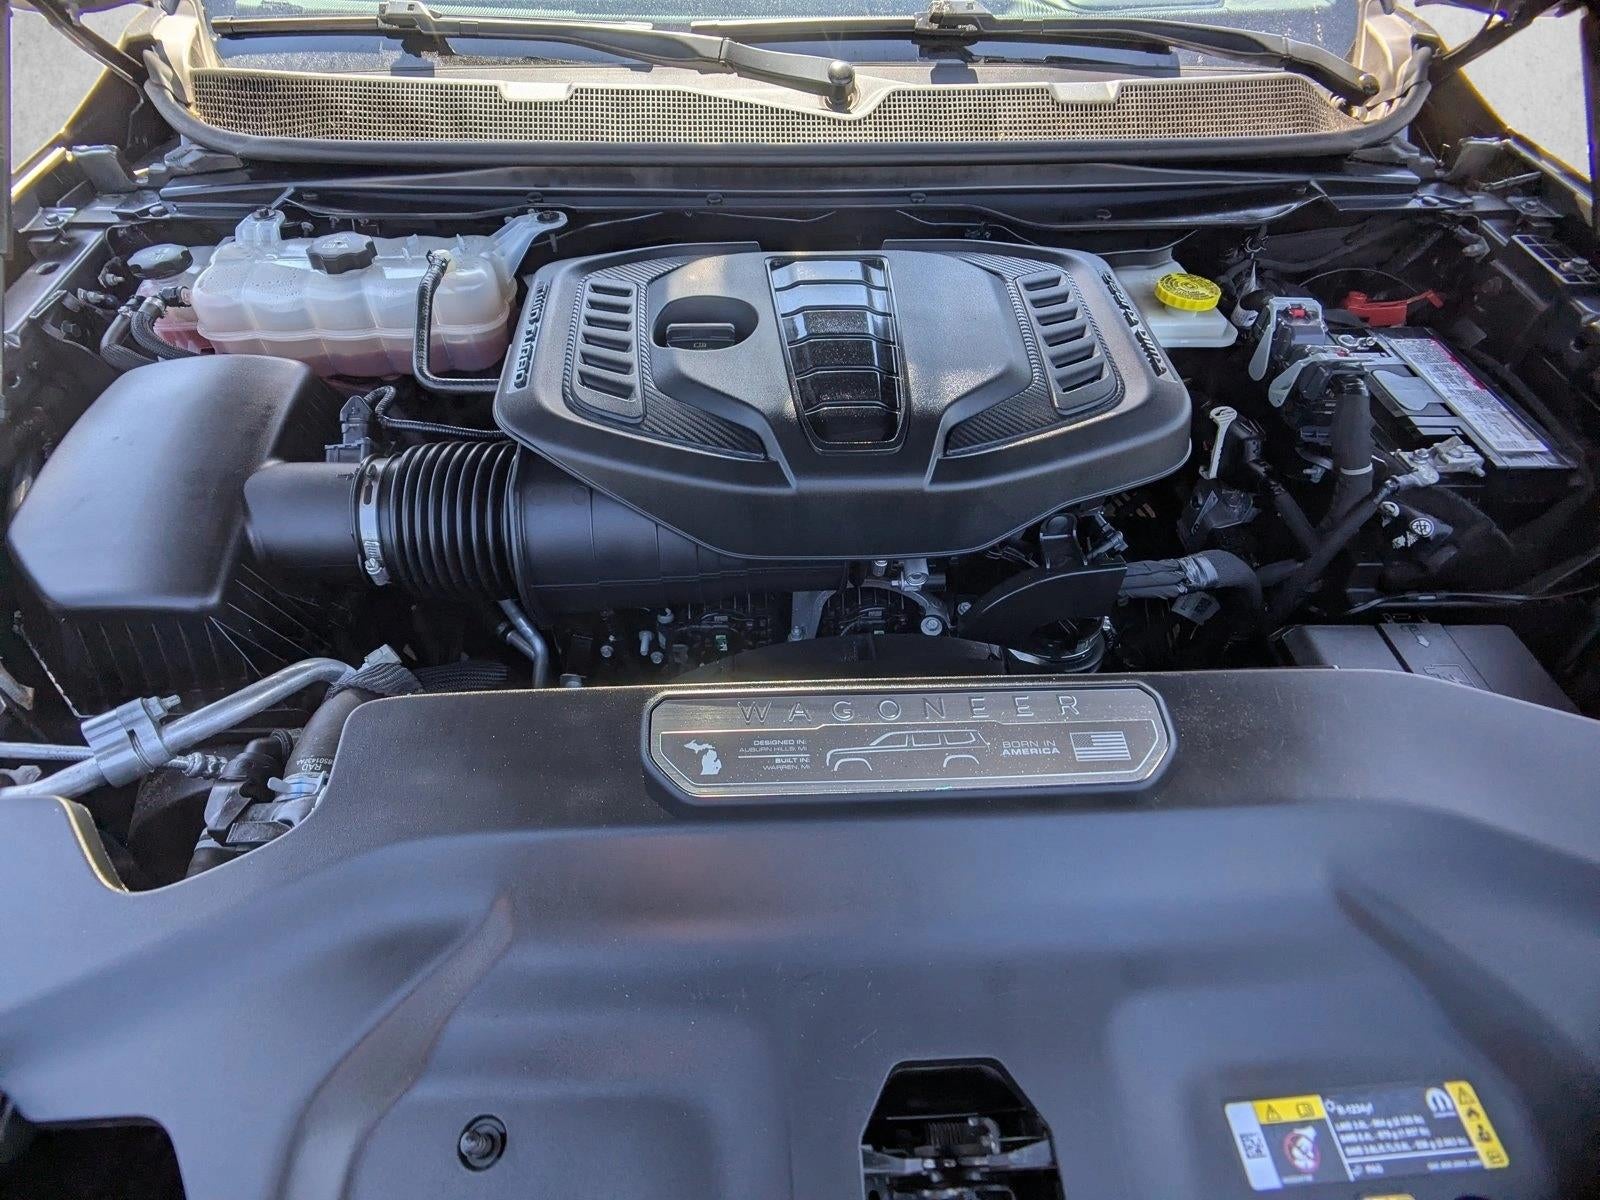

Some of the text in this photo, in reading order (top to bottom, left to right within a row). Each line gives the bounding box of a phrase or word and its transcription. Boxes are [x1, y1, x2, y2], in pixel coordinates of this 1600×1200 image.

[737, 695, 1081, 725] WAGONEER
[1002, 739, 1057, 748] BORN IN
[1002, 747, 1061, 756] AMERICA
[301, 763, 322, 771] RAD
